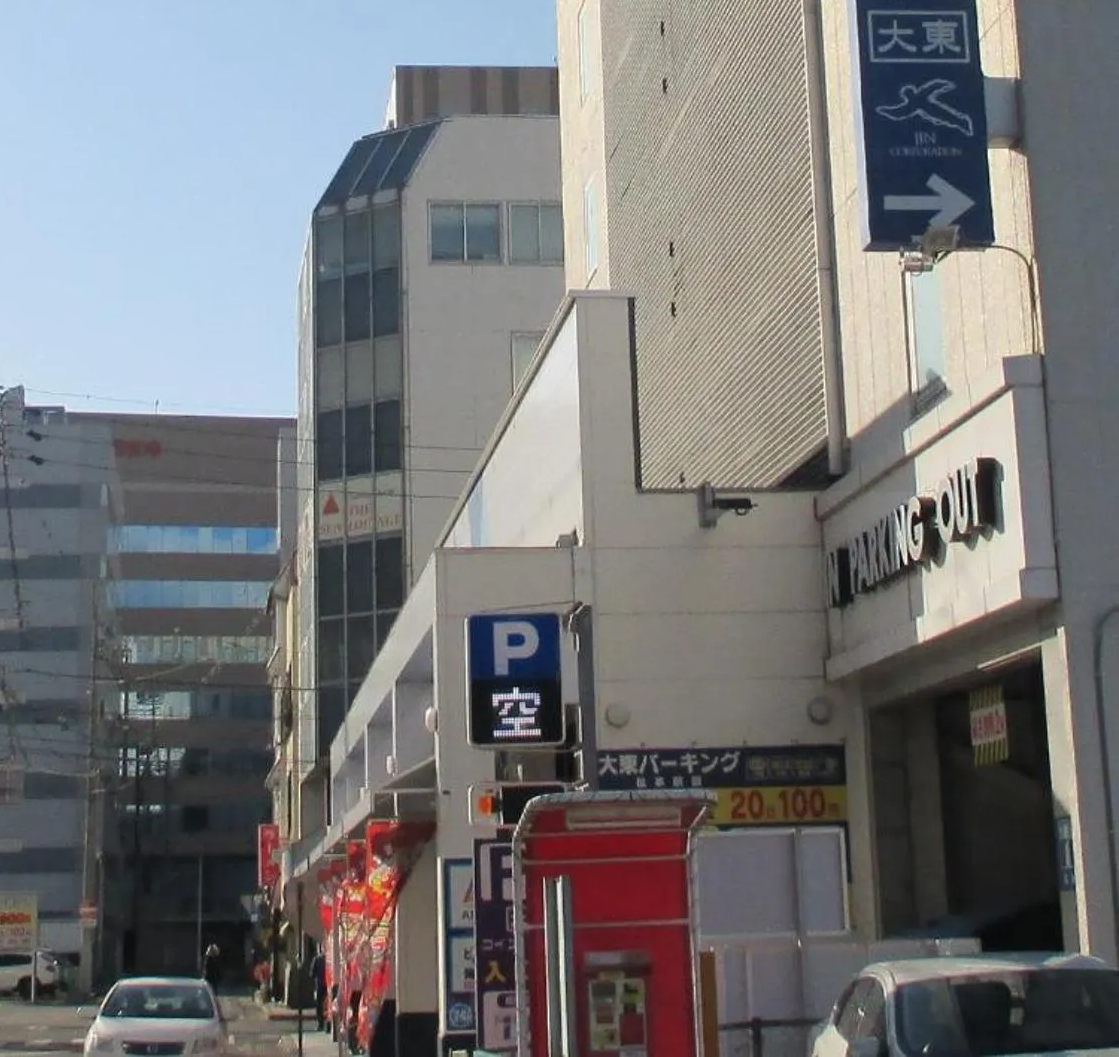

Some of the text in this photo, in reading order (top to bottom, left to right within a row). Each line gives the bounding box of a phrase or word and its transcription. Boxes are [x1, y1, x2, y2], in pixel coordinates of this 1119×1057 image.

[878, 20, 961, 54] 大東
[849, 496, 925, 596] PARKING
[936, 456, 983, 544] OUT
[493, 621, 540, 676] P
[492, 686, 542, 738] 空
